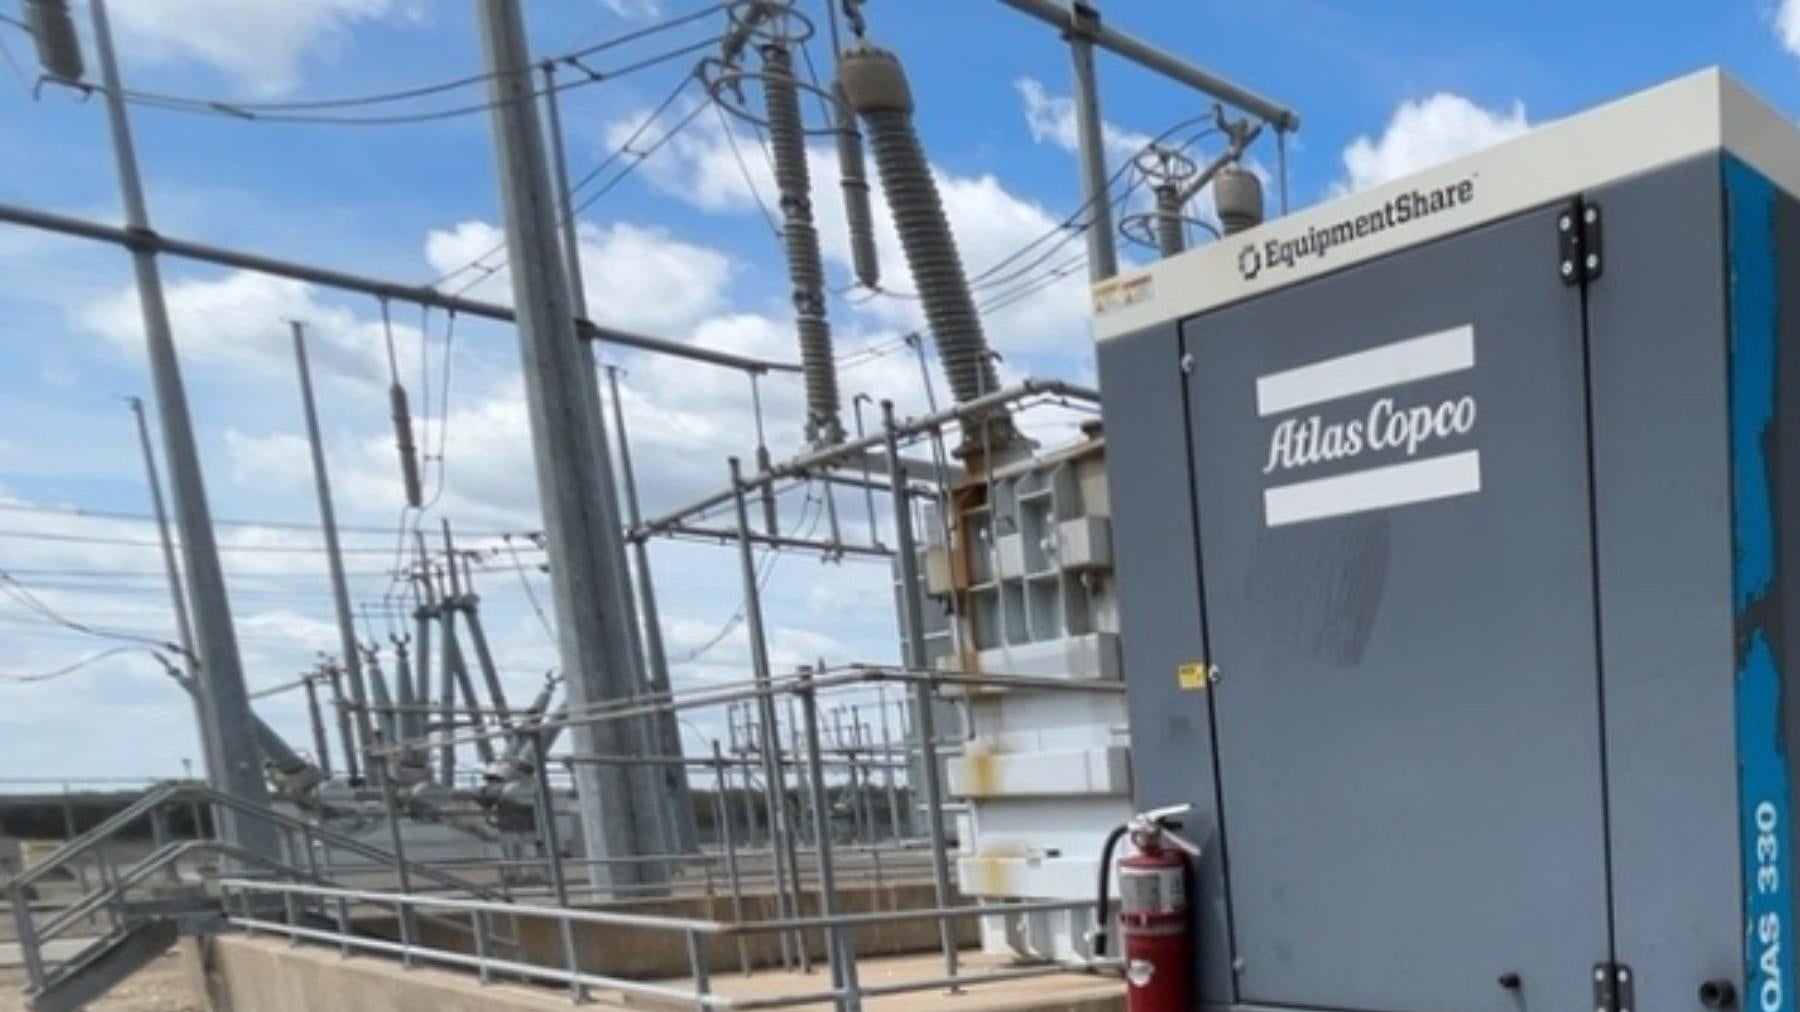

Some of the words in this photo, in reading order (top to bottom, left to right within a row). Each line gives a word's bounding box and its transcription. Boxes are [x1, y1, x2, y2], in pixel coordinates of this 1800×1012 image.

[1264, 178, 1475, 268] EquipmentShare
[1262, 413, 1363, 474] Atlas
[1367, 395, 1476, 456] Copco
[1755, 801, 1780, 893] 330
